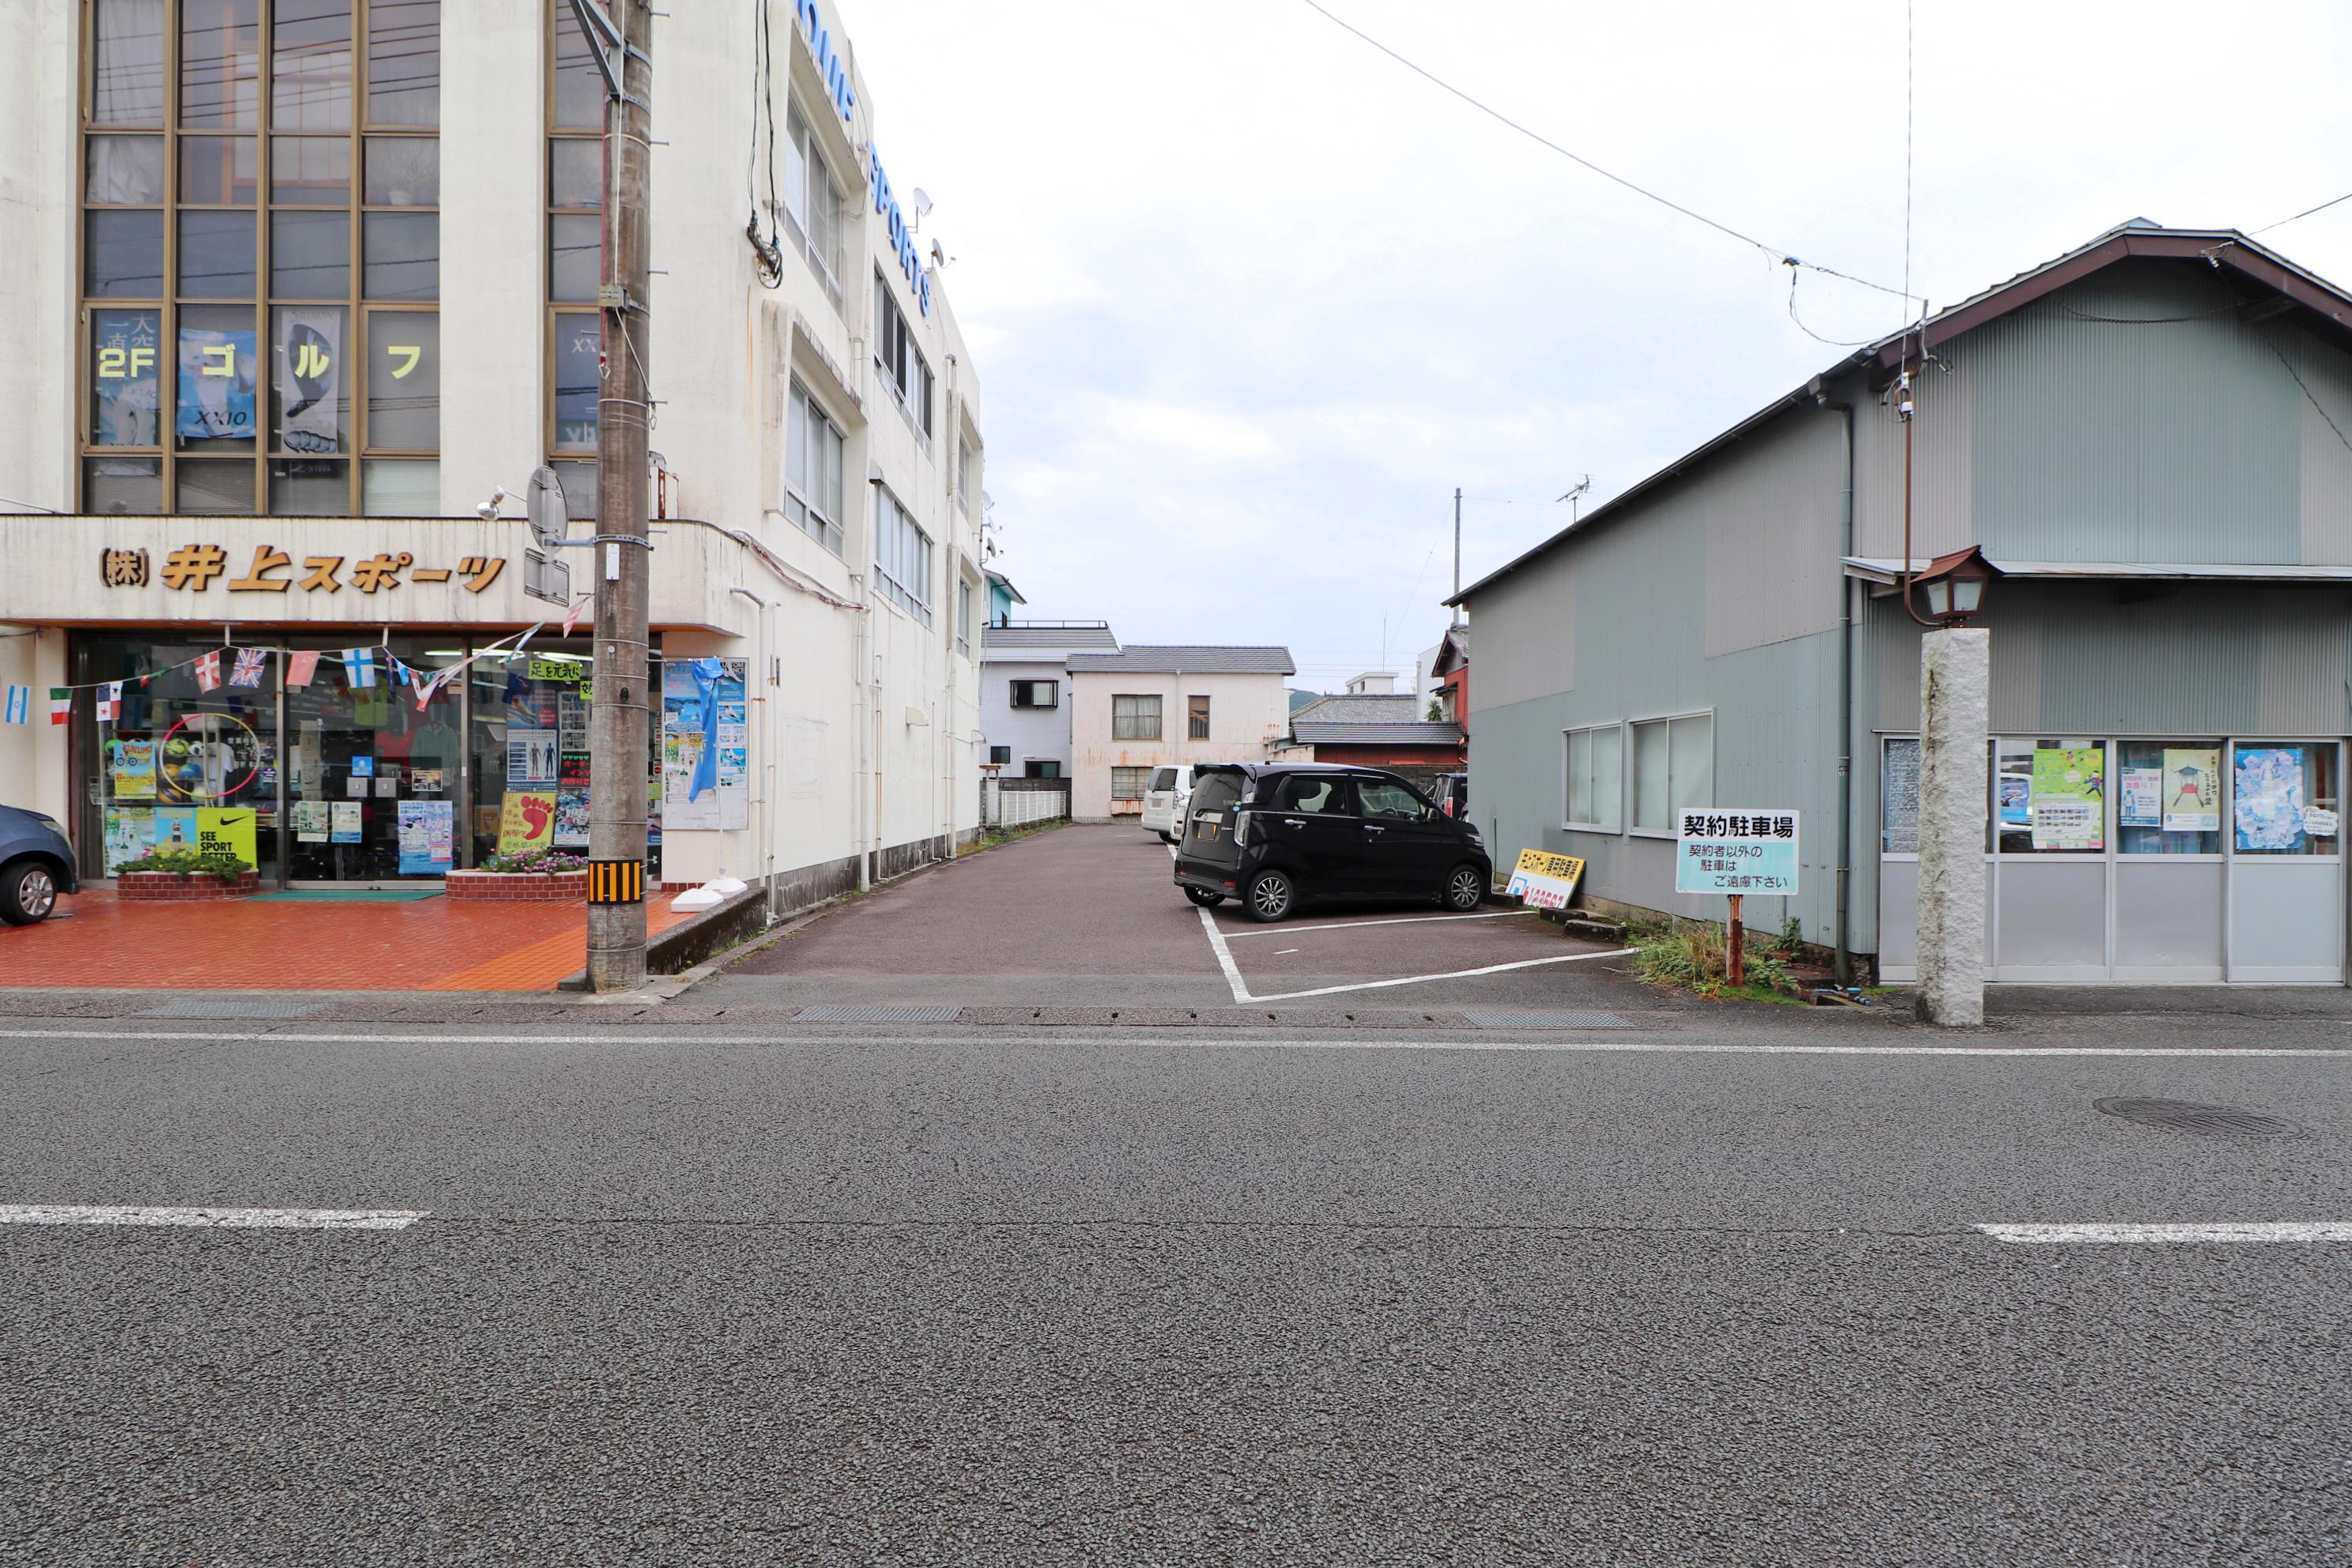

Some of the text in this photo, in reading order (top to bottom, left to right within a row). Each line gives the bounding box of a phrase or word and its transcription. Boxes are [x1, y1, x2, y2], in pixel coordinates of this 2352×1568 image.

[869, 138, 930, 317] SPORTS
[99, 348, 156, 378] 2F
[194, 411, 247, 425] XXIO
[530, 662, 580, 679] 足を元気に
[1684, 815, 1794, 839] 契約駐車場
[200, 831, 217, 841] SEE
[200, 842, 232, 851] SPORT
[1688, 845, 1762, 858] 契約者以外の
[1700, 859, 1737, 872] 駐車は
[1713, 875, 1788, 888] ご遠慮下さい
